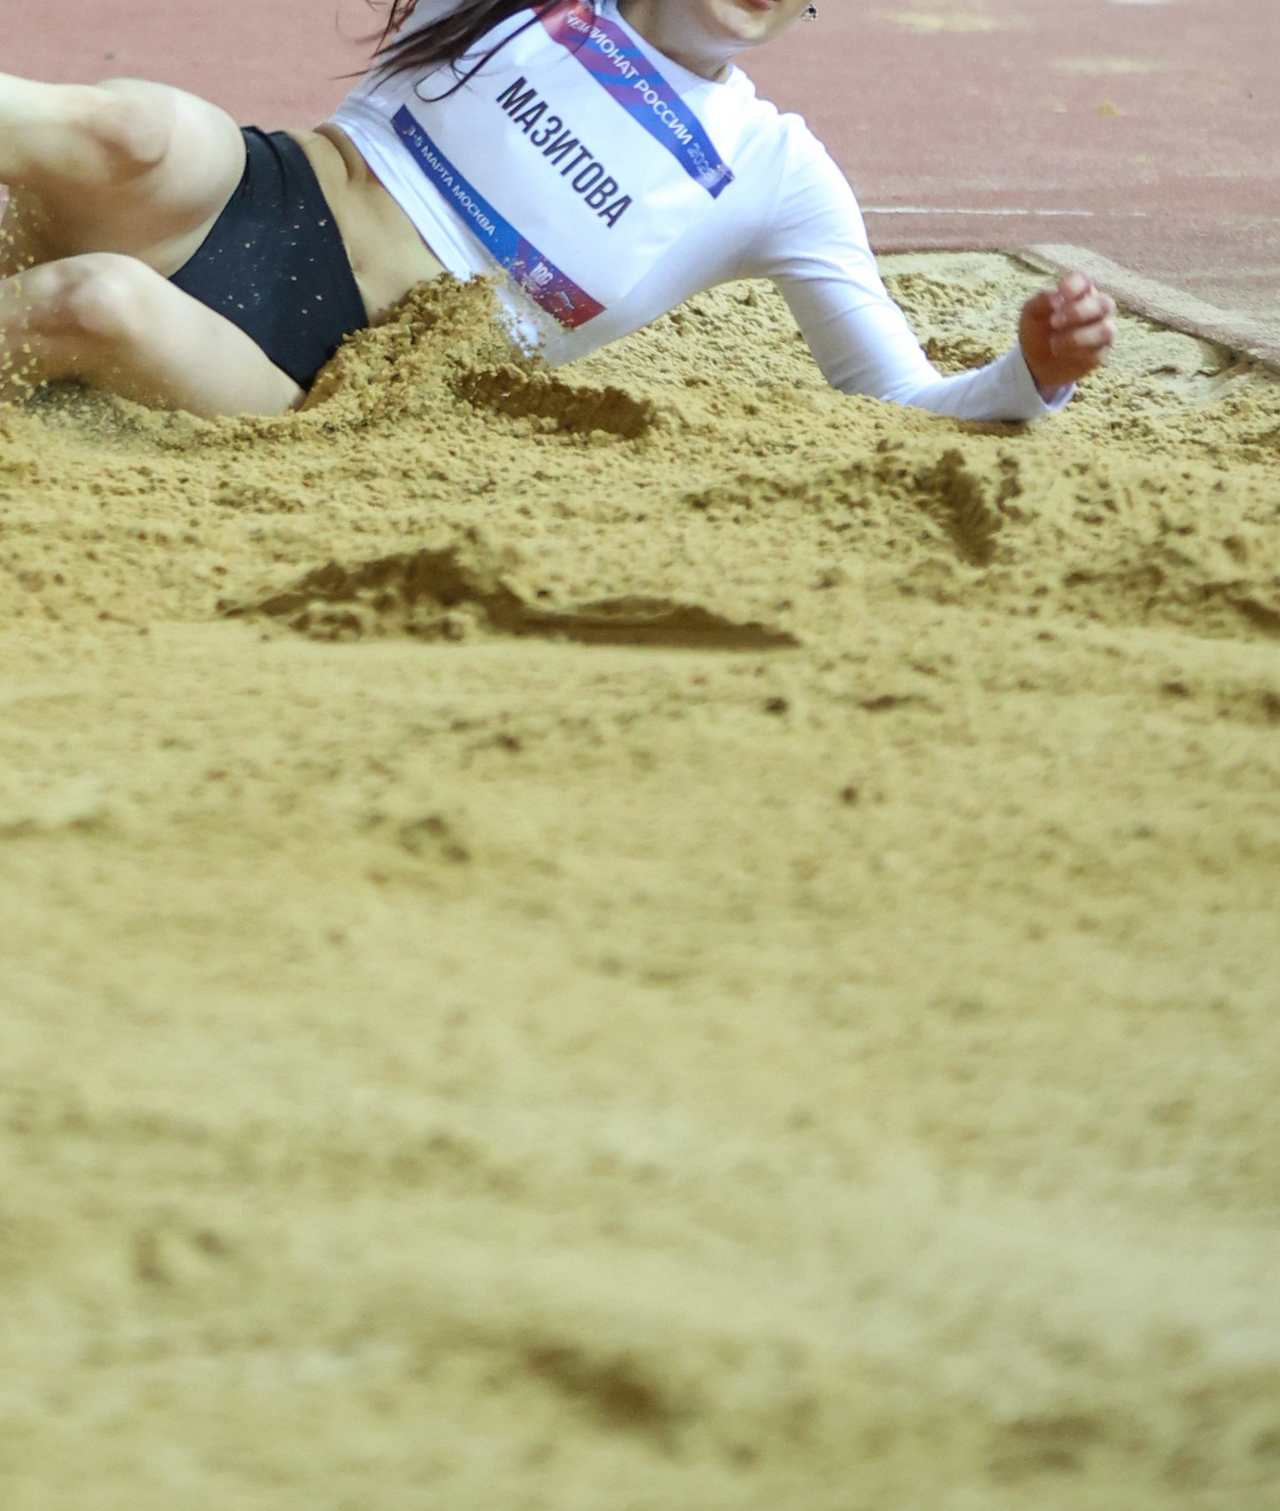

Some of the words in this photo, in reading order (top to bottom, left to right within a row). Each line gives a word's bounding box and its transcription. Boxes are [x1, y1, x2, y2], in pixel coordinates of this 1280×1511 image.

[495, 75, 634, 230] МАЗИТОВА
[633, 78, 693, 145] РОССИИ
[421, 145, 454, 187] МАРТА
[452, 184, 496, 237] МОСКВА
